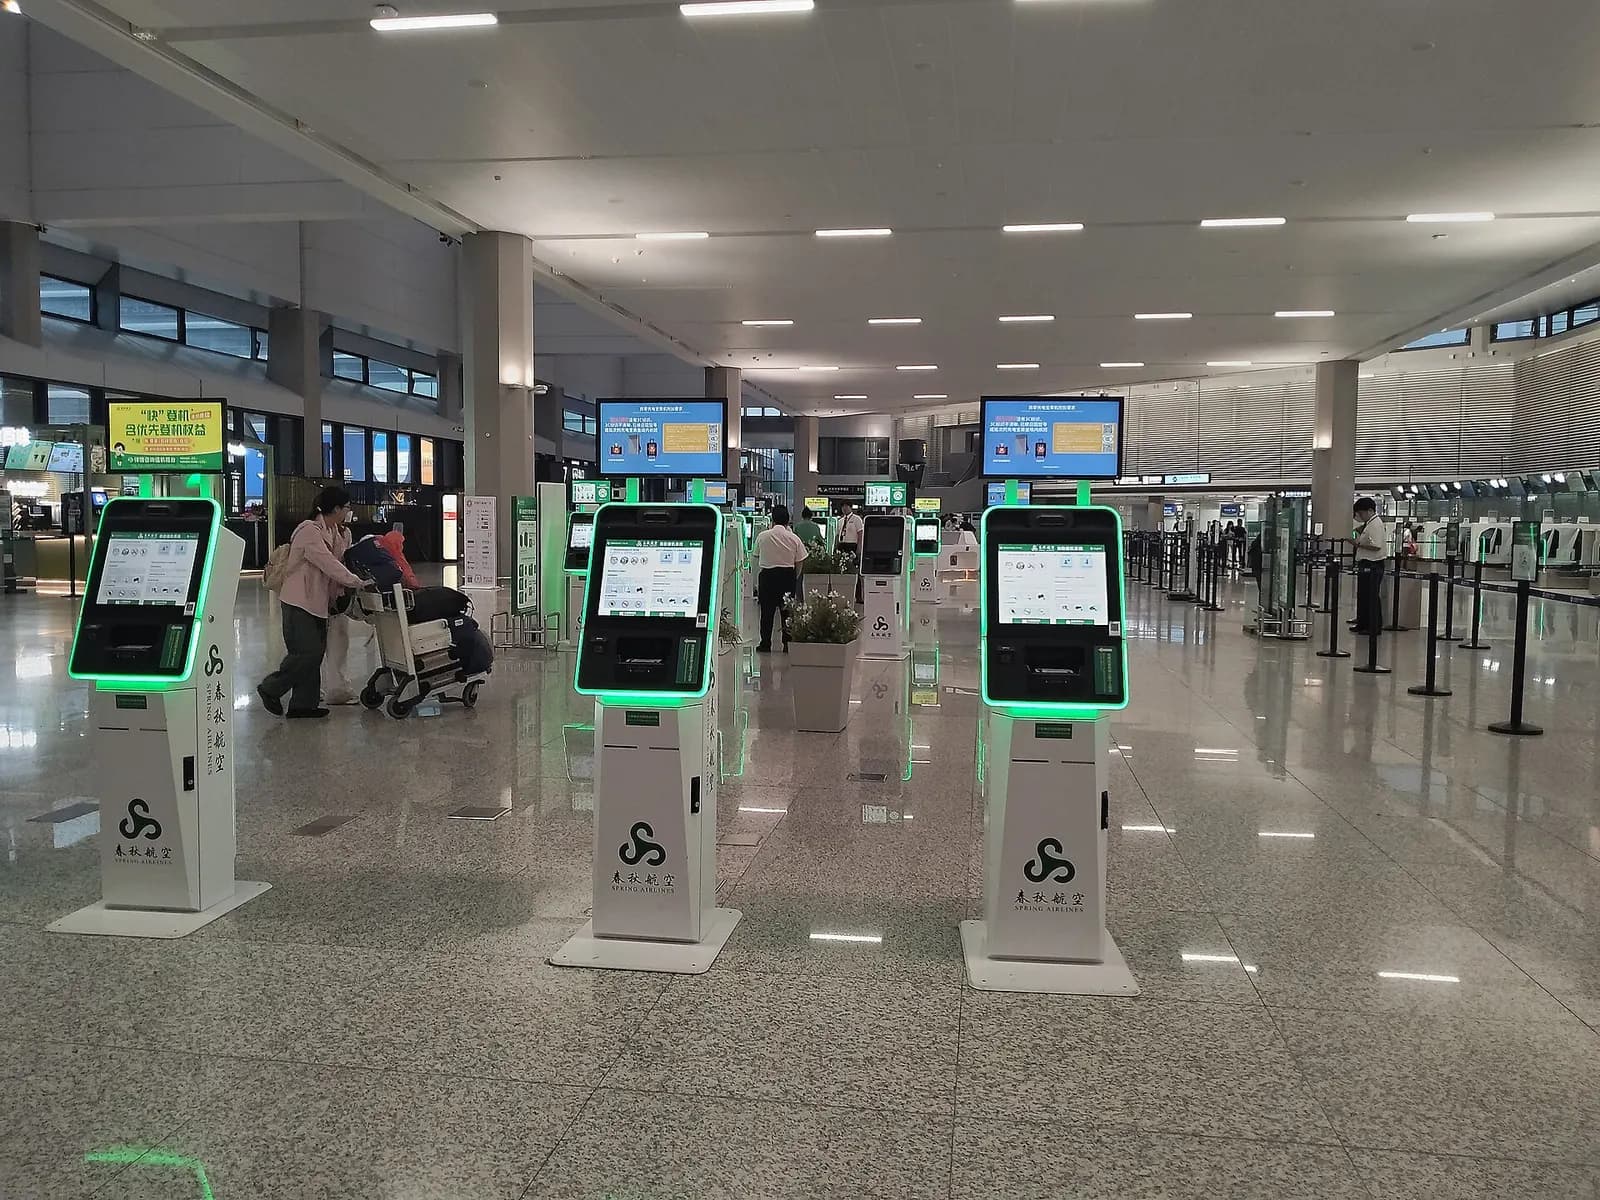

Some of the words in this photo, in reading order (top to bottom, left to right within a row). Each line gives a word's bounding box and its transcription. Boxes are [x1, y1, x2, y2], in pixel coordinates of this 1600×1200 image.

[125, 423, 206, 436] 含优先登机权益
[213, 681, 226, 773] 春秋航空
[115, 844, 172, 859] 春秋航空
[611, 870, 675, 887] 春秋航空
[1014, 889, 1085, 906] 春秋航空
